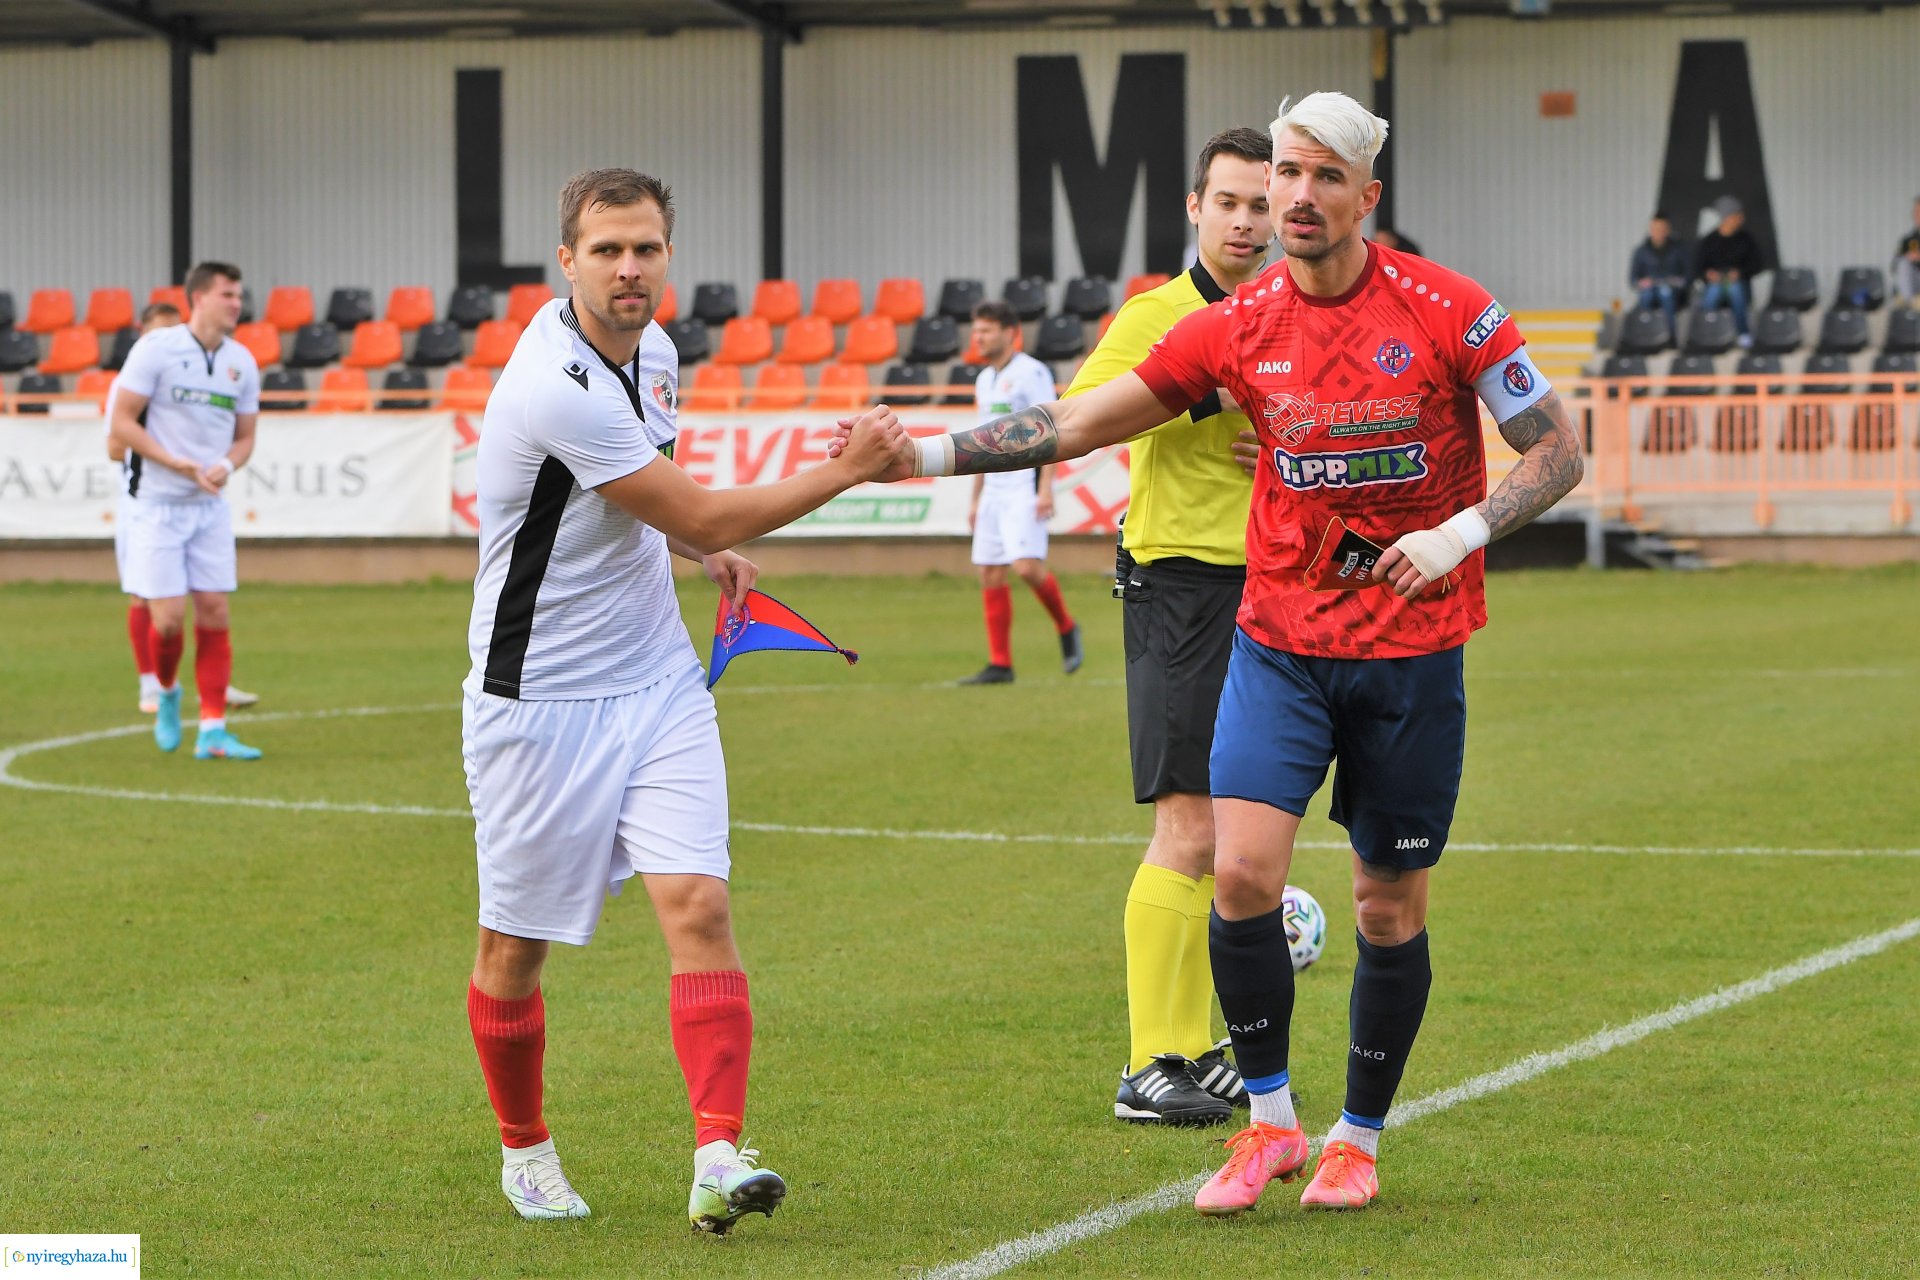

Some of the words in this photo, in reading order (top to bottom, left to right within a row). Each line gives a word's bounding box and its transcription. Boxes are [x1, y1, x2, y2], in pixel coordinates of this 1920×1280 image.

[1016, 54, 1186, 281] M
[1653, 40, 1779, 270] A
[1256, 361, 1292, 374] JAKO
[1315, 394, 1422, 426] REVESZ
[1332, 425, 1358, 434] ALWAYS
[1381, 421, 1401, 430] RIGHT
[1401, 418, 1417, 427] WAY
[1356, 558, 1375, 580] MFC
[1395, 837, 1429, 850] JAKO
